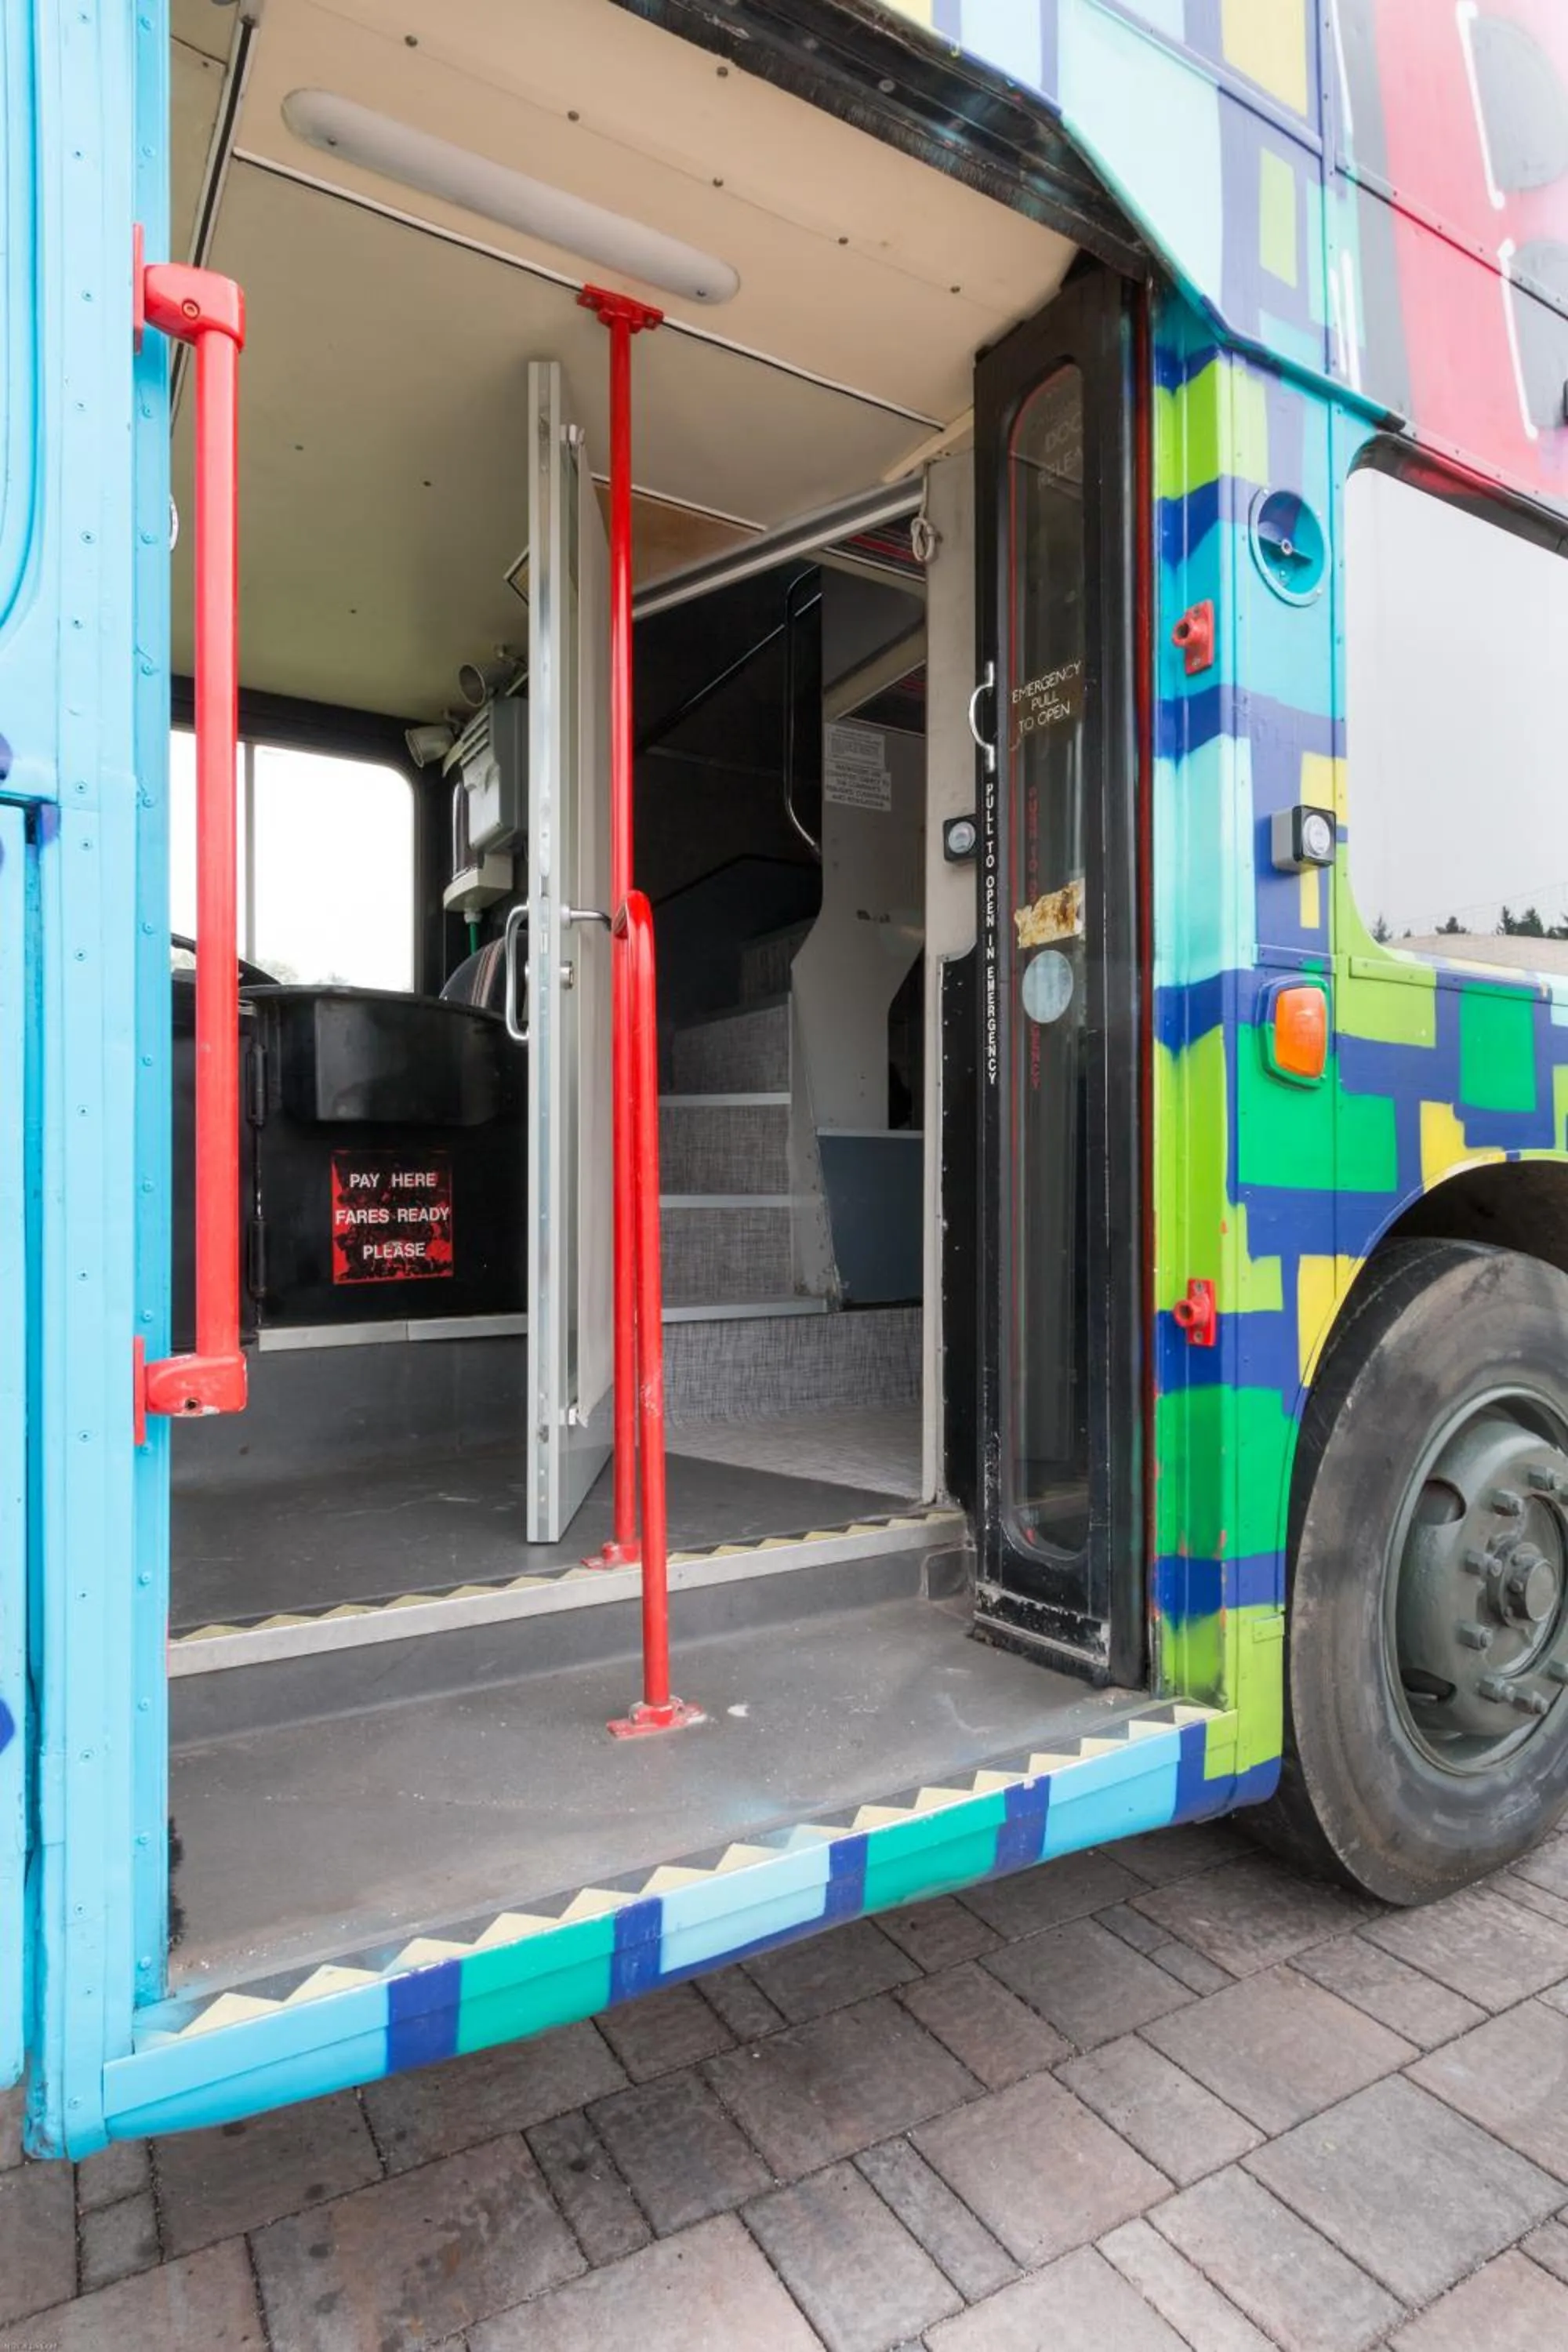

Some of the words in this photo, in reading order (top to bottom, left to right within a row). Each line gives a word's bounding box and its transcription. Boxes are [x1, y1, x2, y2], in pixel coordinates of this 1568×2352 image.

[1012, 659, 1081, 703] EMERGENCY
[1031, 690, 1059, 711] PULL
[1018, 717, 1034, 734] TO
[1037, 699, 1070, 726] OPEN
[985, 783, 994, 836] PULL
[985, 841, 995, 868] TO
[985, 876, 995, 927] OPEN
[986, 934, 995, 960] IN
[986, 966, 996, 1085] EMERGENCY
[350, 1173, 380, 1189] PAY
[391, 1173, 437, 1189] HERE
[335, 1208, 390, 1225] FARES
[397, 1207, 450, 1223] READY
[363, 1242, 426, 1260] PLEASE
